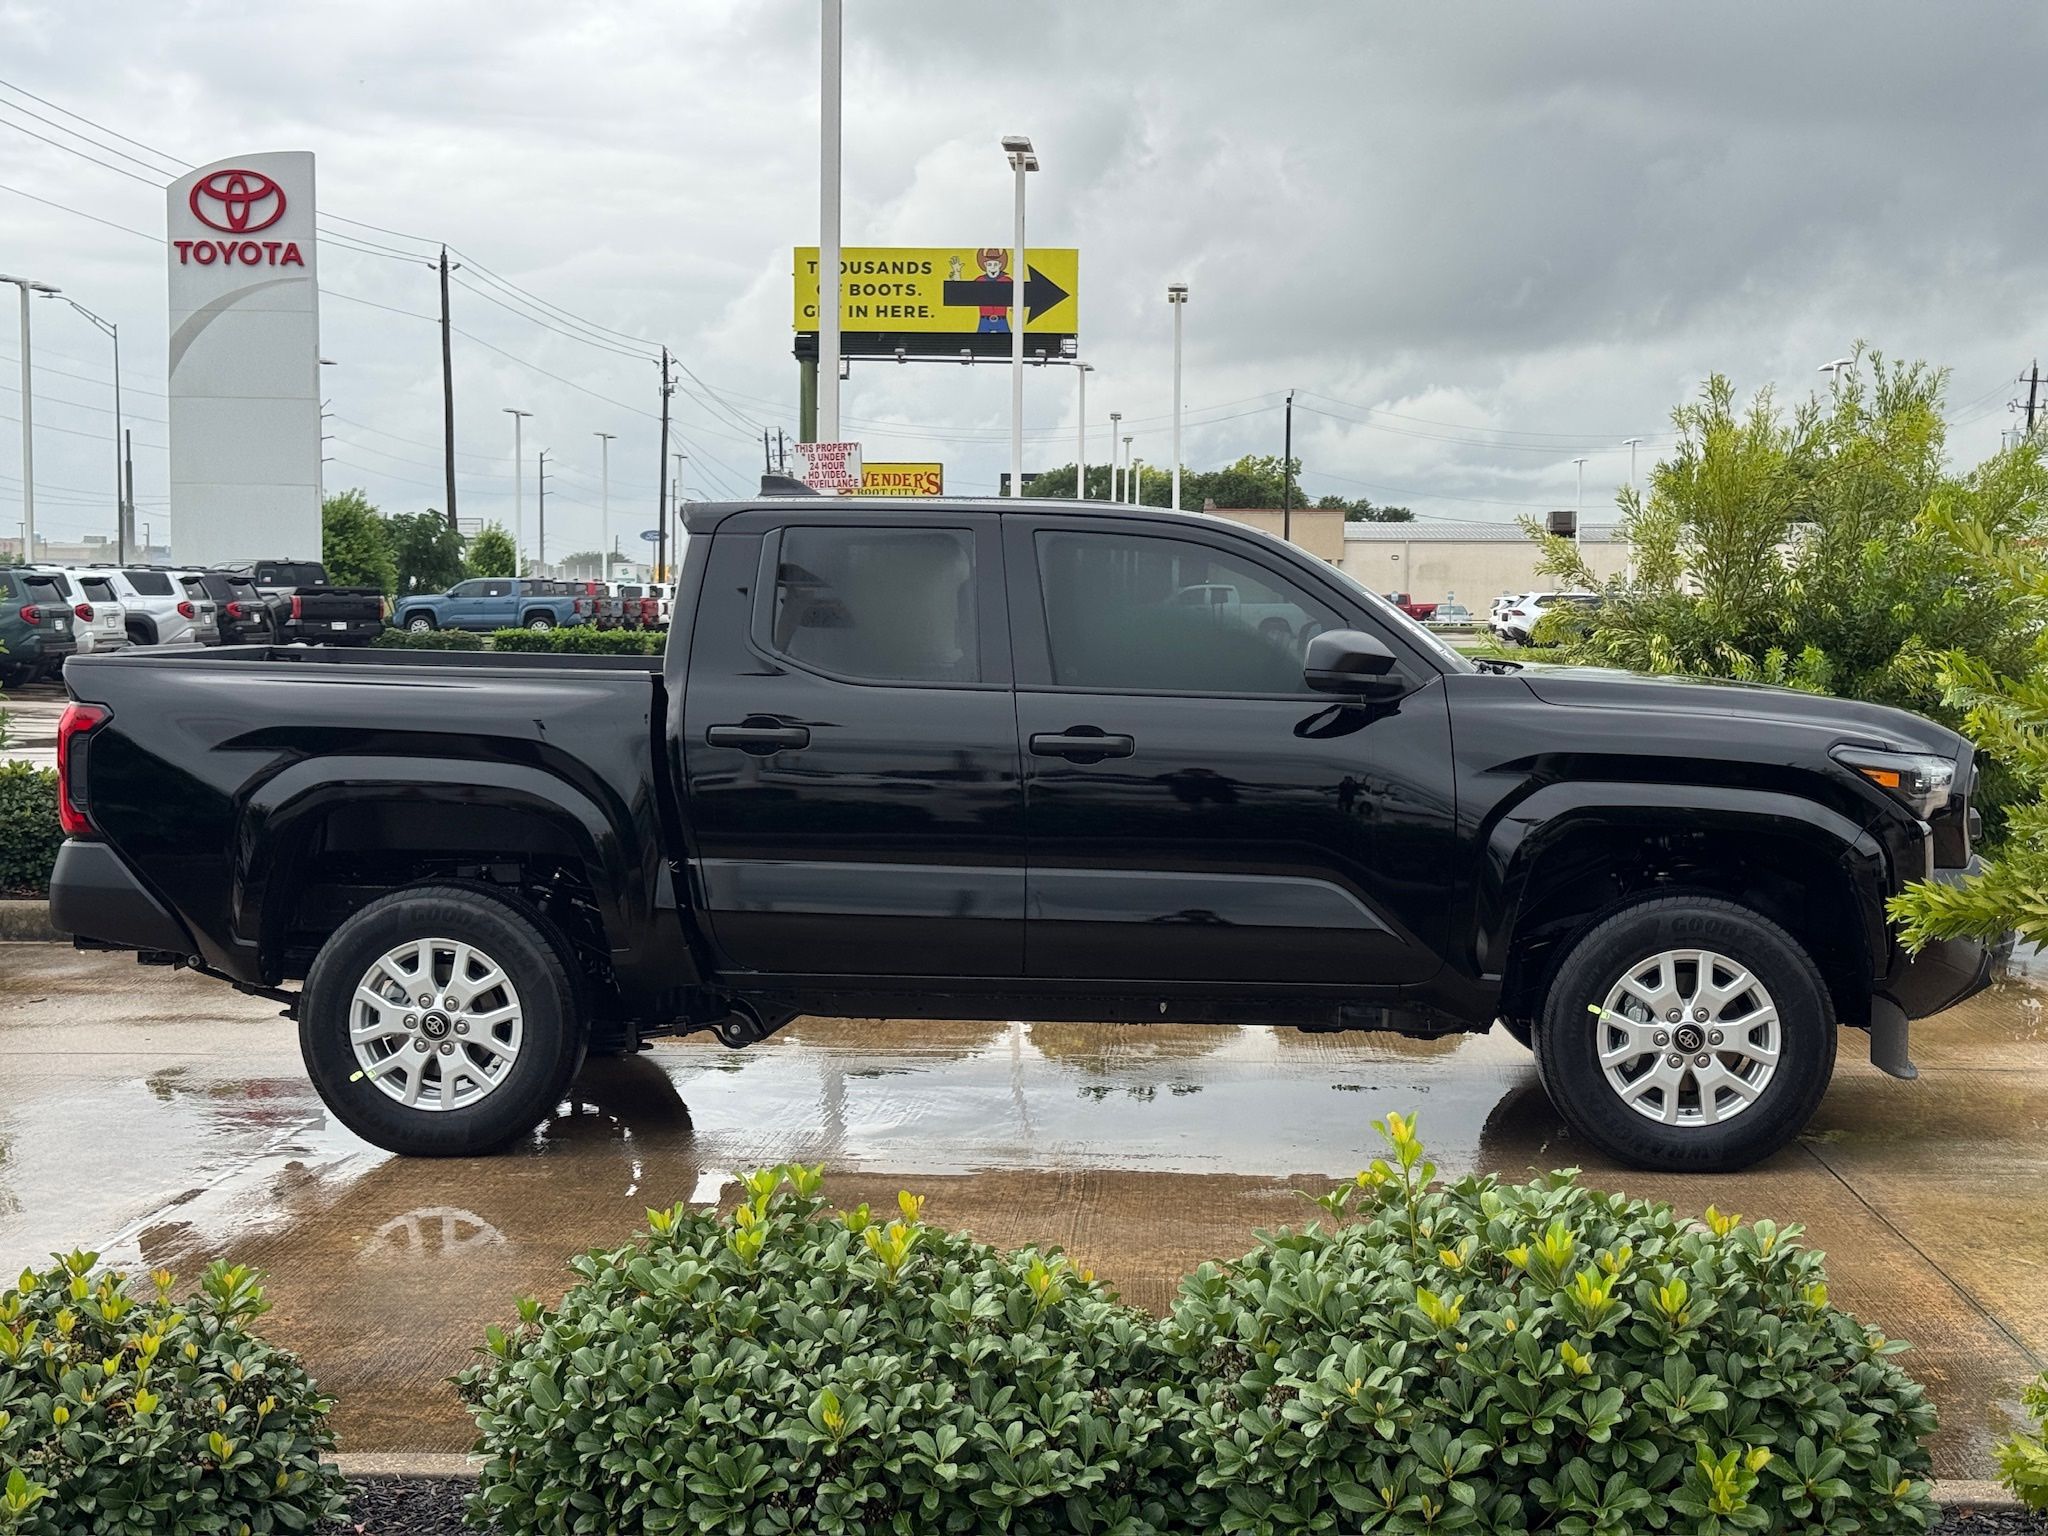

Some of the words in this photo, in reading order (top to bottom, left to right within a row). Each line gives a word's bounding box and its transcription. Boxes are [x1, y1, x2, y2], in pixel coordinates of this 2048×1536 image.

[173, 240, 305, 267] TOYOTA
[806, 261, 932, 275] TOUSANDS
[849, 283, 922, 297] BOOTS.
[848, 304, 869, 318] IN
[875, 304, 935, 318] HERE.
[794, 443, 814, 454] THIS
[815, 442, 859, 453] PROPERTY
[807, 453, 816, 462] IS
[817, 452, 846, 462] UNDER
[809, 462, 820, 471] 24
[821, 461, 846, 470] HOUR
[808, 471, 820, 480] HD
[821, 470, 847, 480] VIDEO
[801, 478, 860, 489] URVEILLANCE
